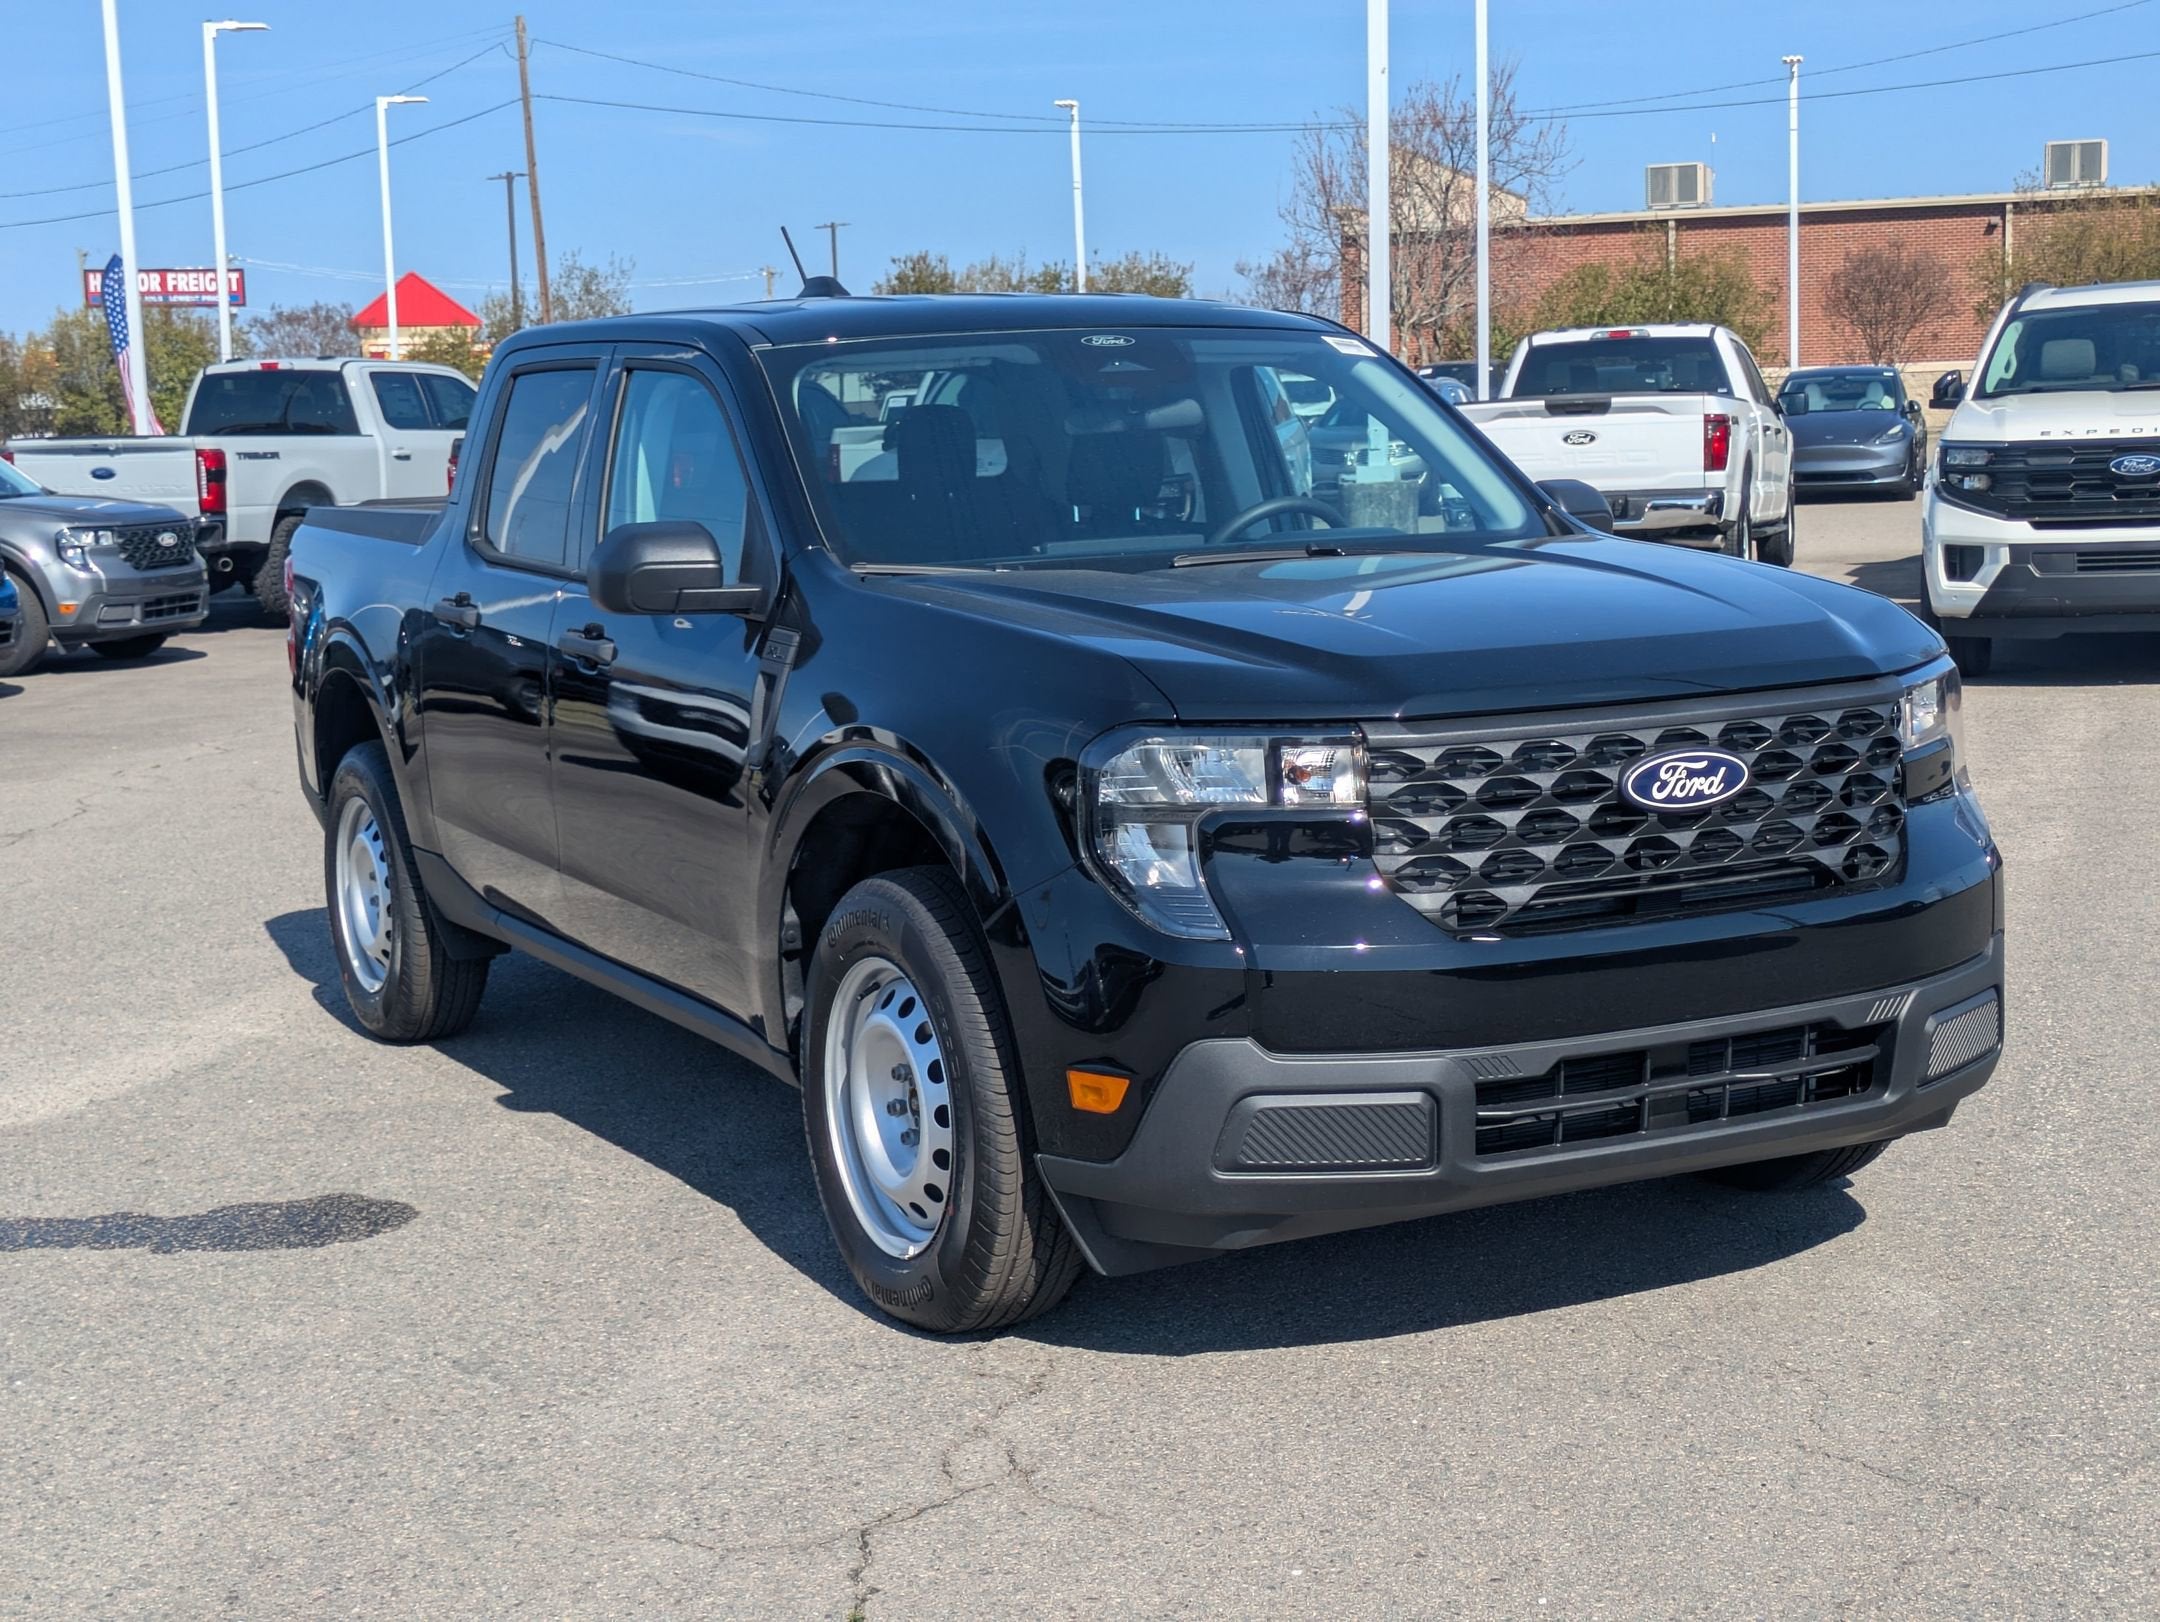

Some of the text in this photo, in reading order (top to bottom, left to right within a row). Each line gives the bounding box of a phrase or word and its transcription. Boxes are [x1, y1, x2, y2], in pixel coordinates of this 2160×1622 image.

[88, 272, 239, 292] HOR FREIGT
[1652, 760, 1726, 800] Ford
[827, 907, 883, 947] Continental
